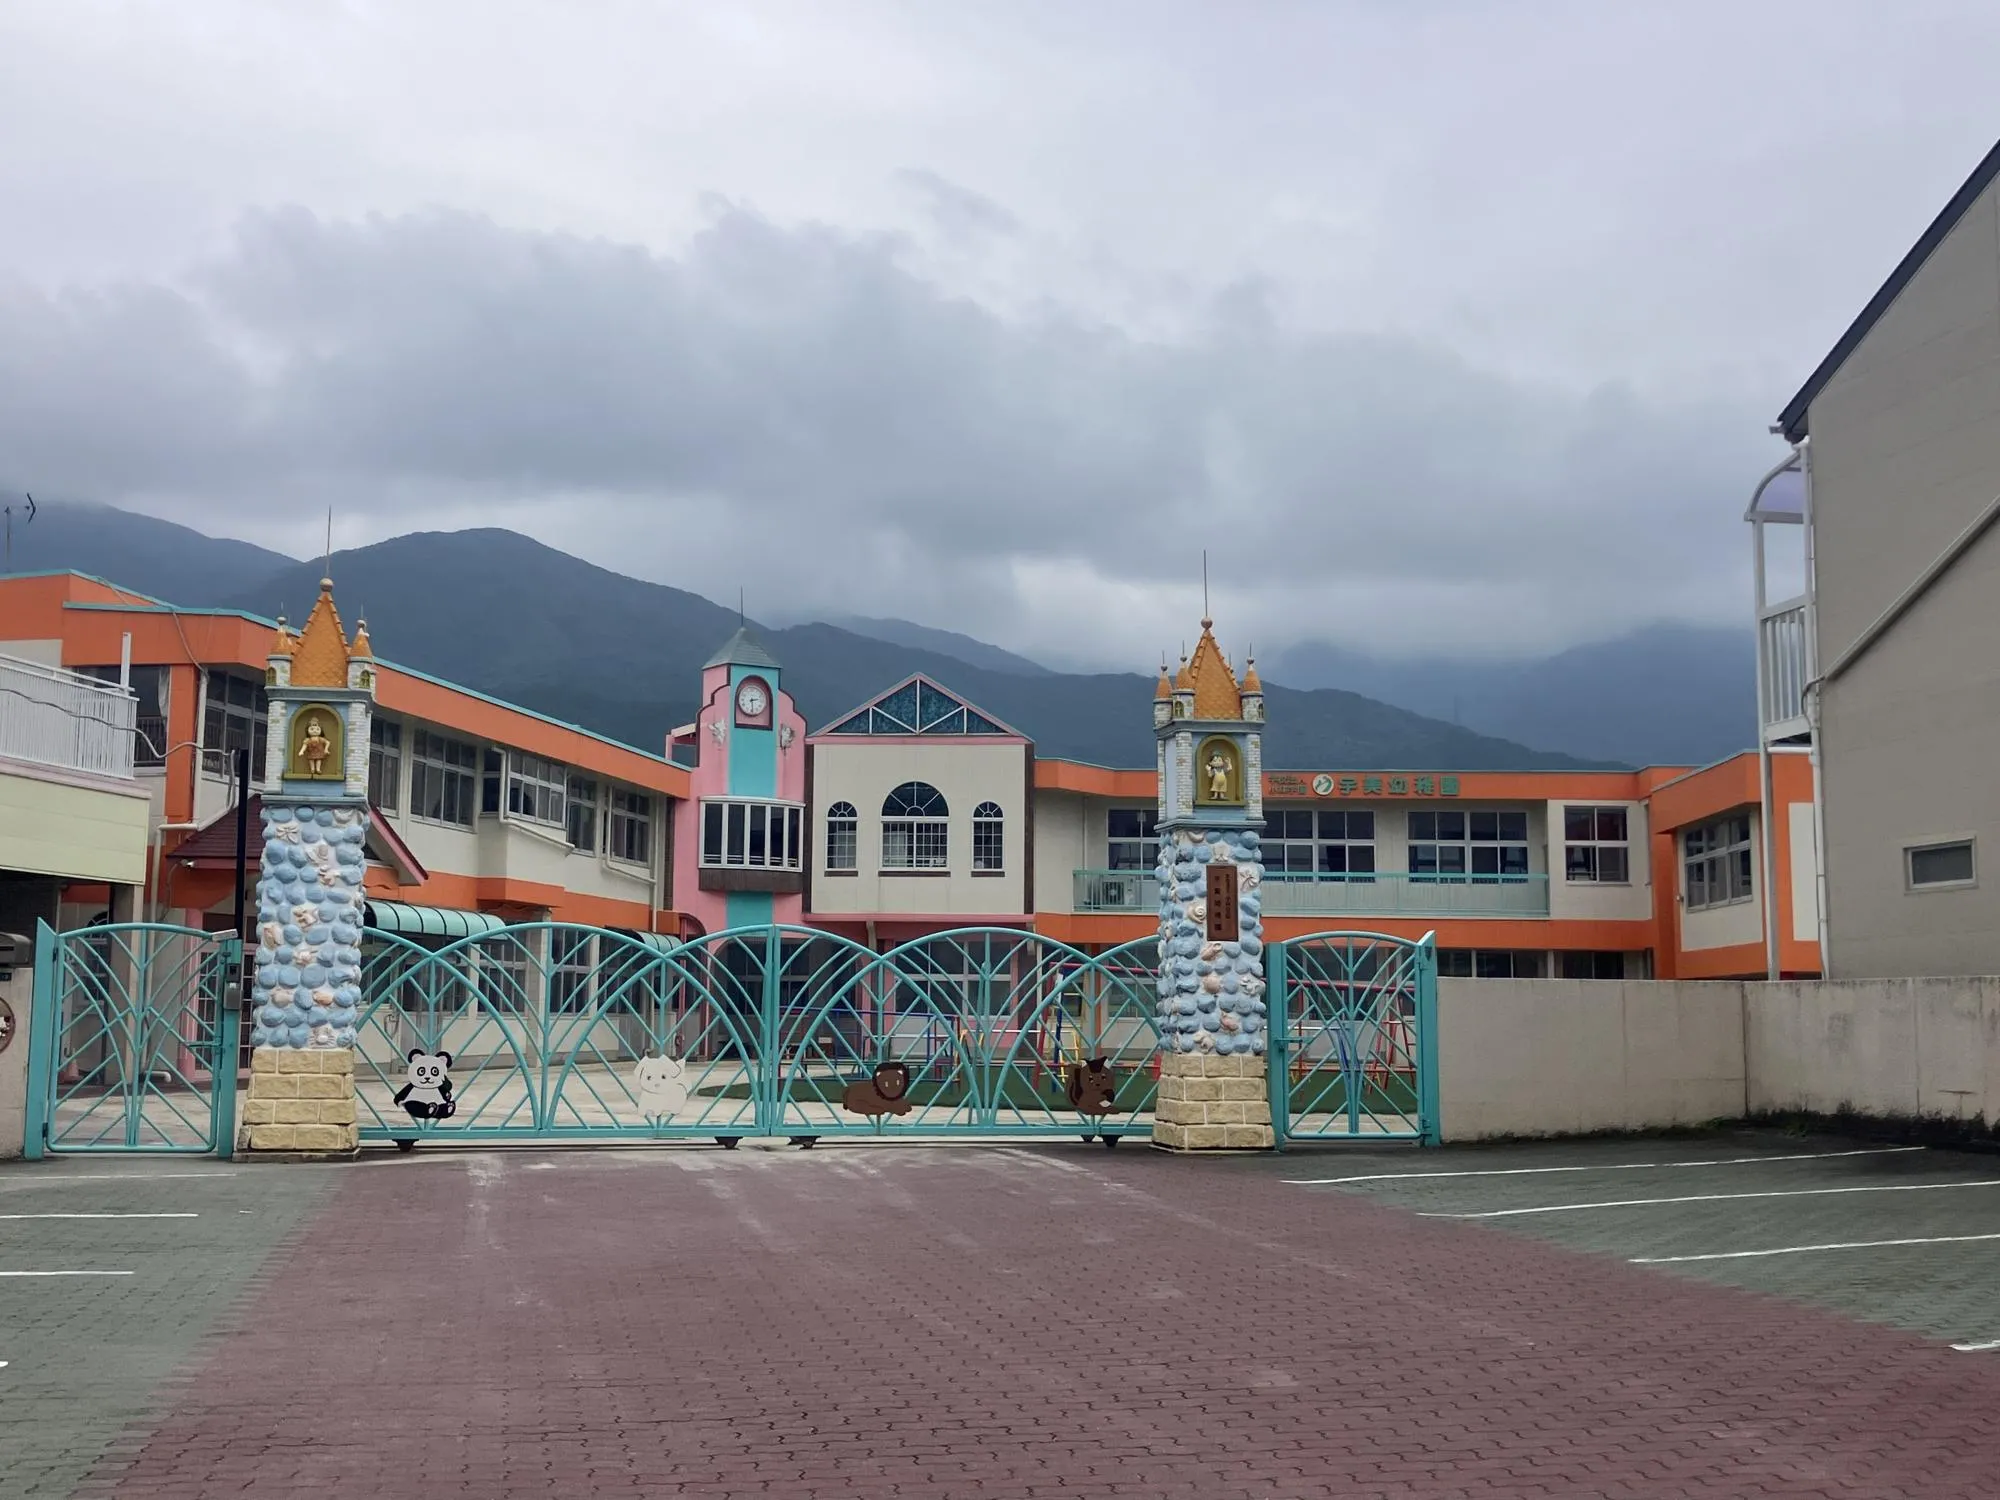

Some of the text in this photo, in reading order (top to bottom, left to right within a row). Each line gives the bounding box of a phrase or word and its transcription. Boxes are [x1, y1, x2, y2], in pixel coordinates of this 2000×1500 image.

[1339, 774, 1459, 796] 宇美幼稚園
